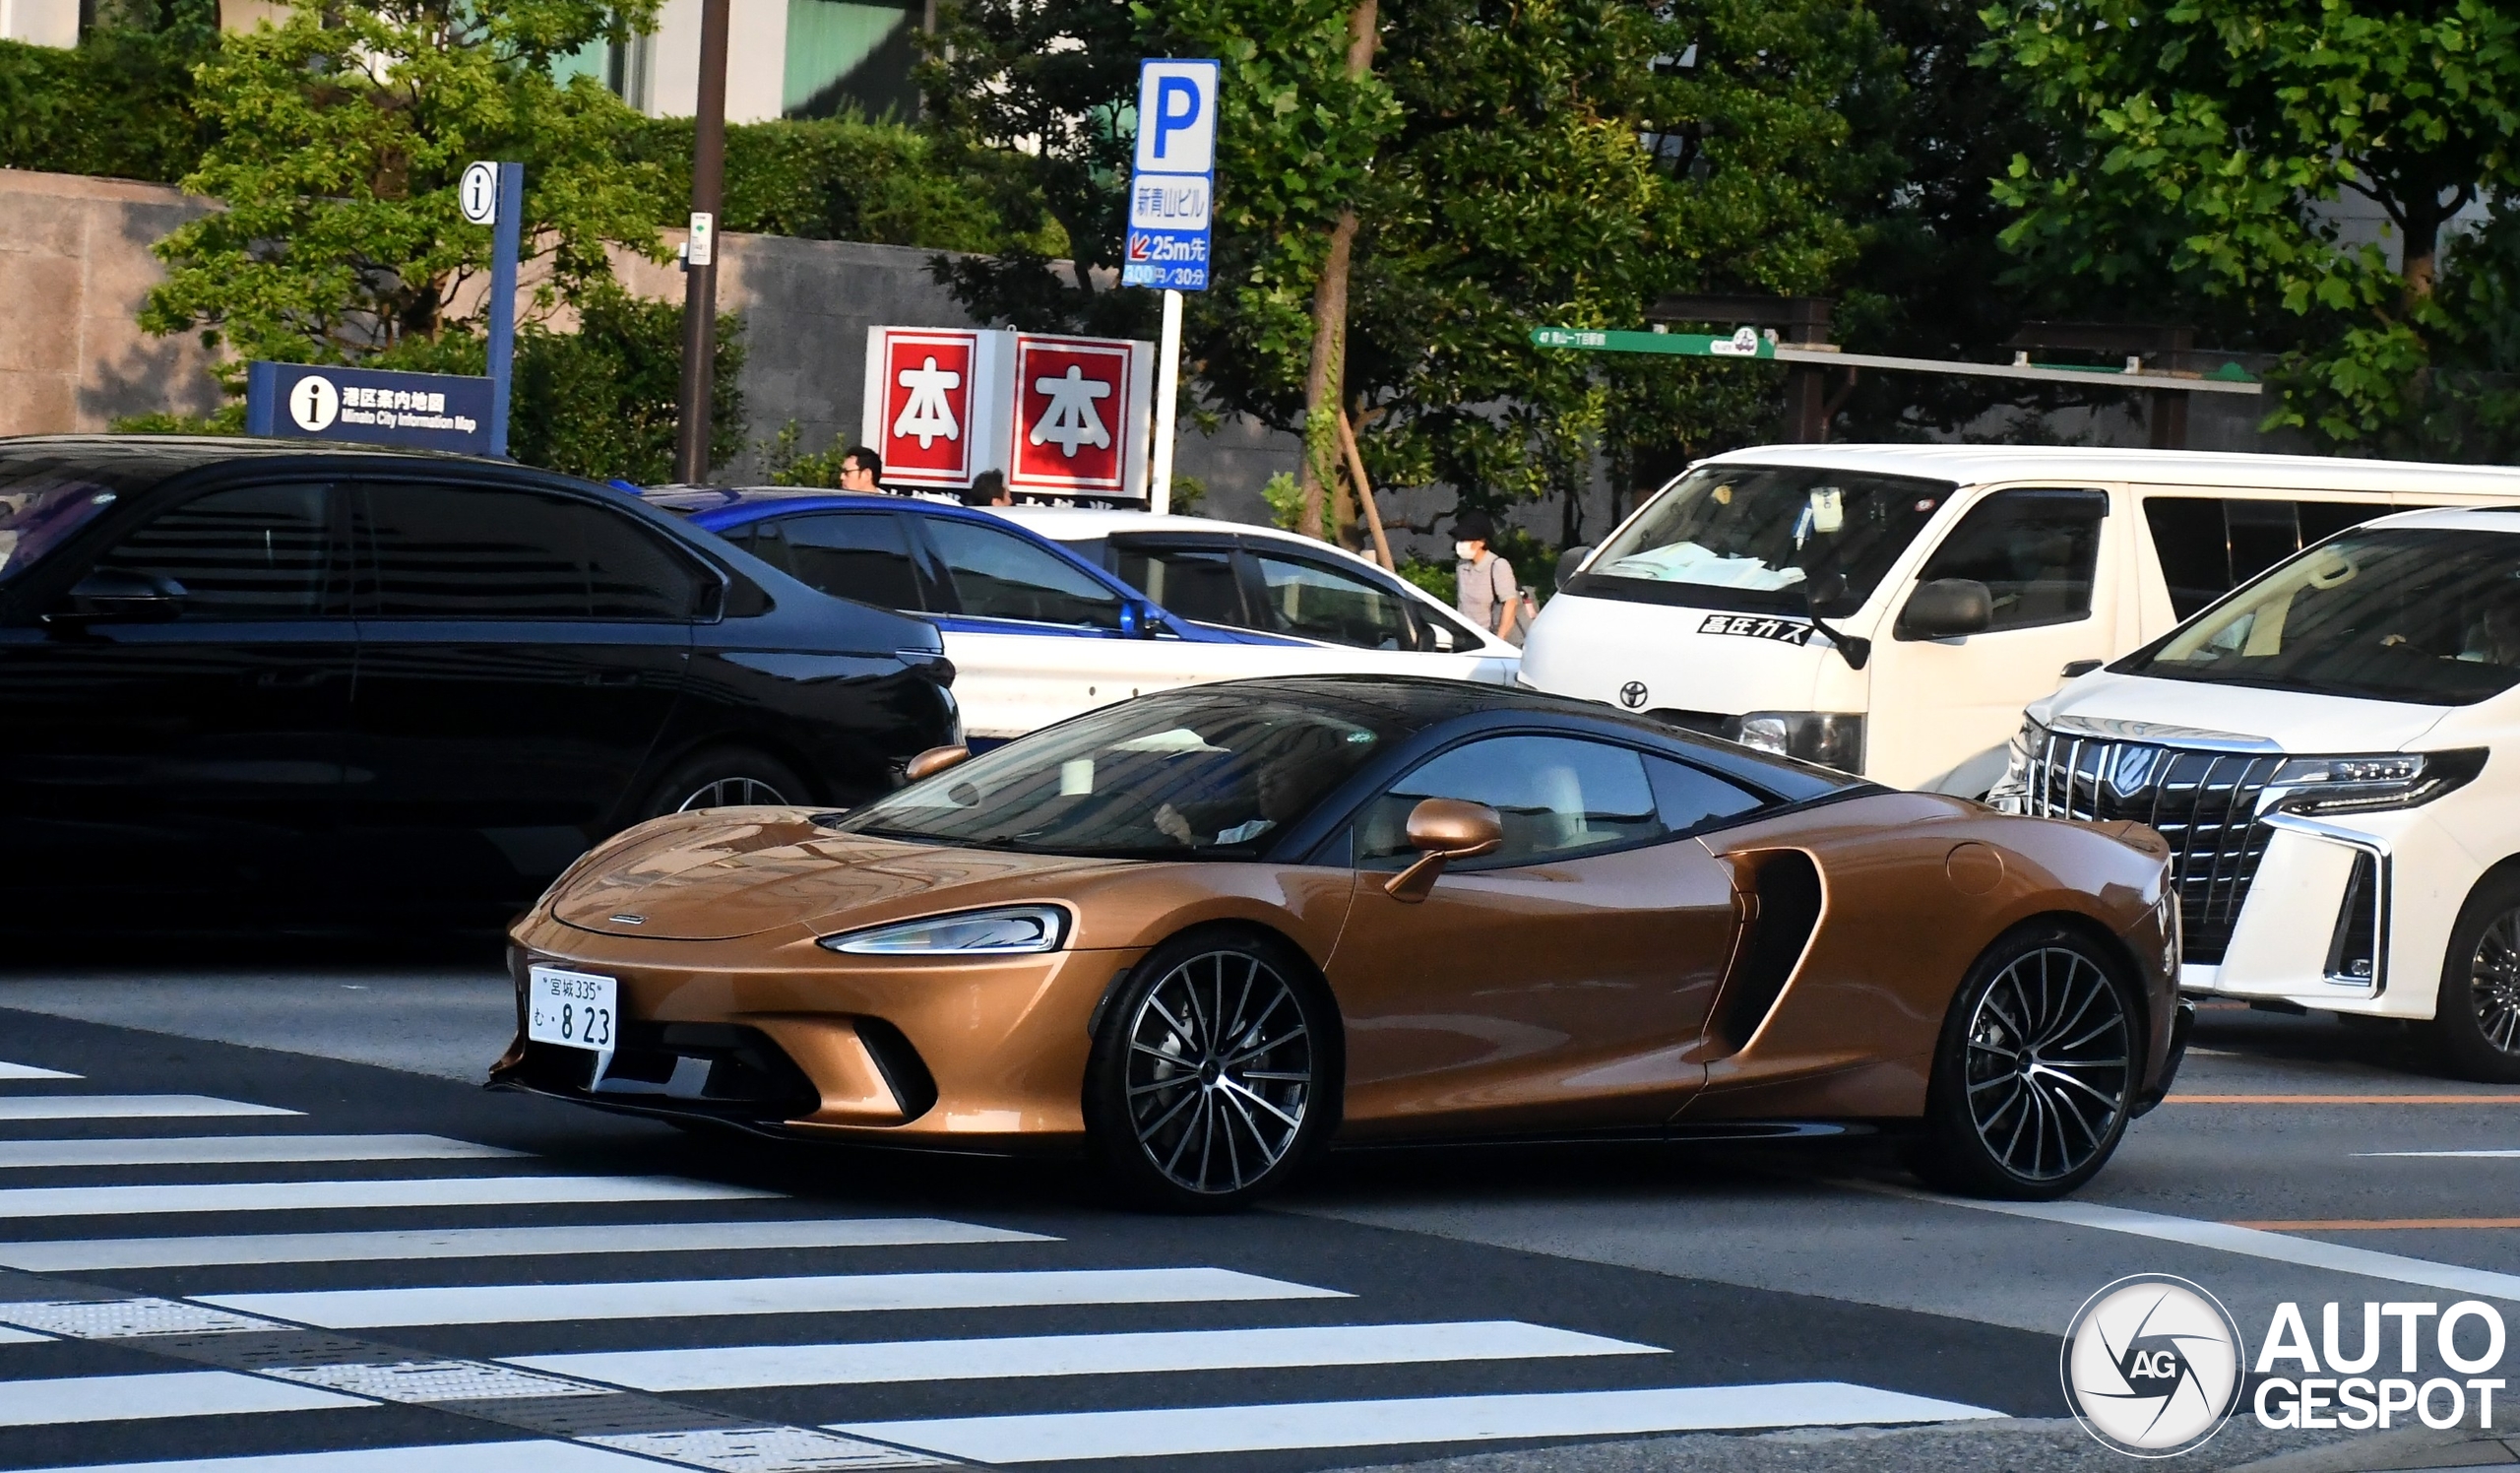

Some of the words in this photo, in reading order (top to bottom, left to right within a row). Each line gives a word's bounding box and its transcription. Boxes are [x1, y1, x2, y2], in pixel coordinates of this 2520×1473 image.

[1153, 76, 1201, 159] P
[1136, 187, 1205, 218] 新青山ビル
[1151, 235, 1207, 262] 25m先
[342, 387, 446, 414] 港区案内地図
[341, 408, 376, 424] Minato
[376, 410, 398, 428] City
[398, 412, 454, 429] Information
[454, 415, 476, 433] Map
[1700, 615, 1810, 644] 高圧ガス
